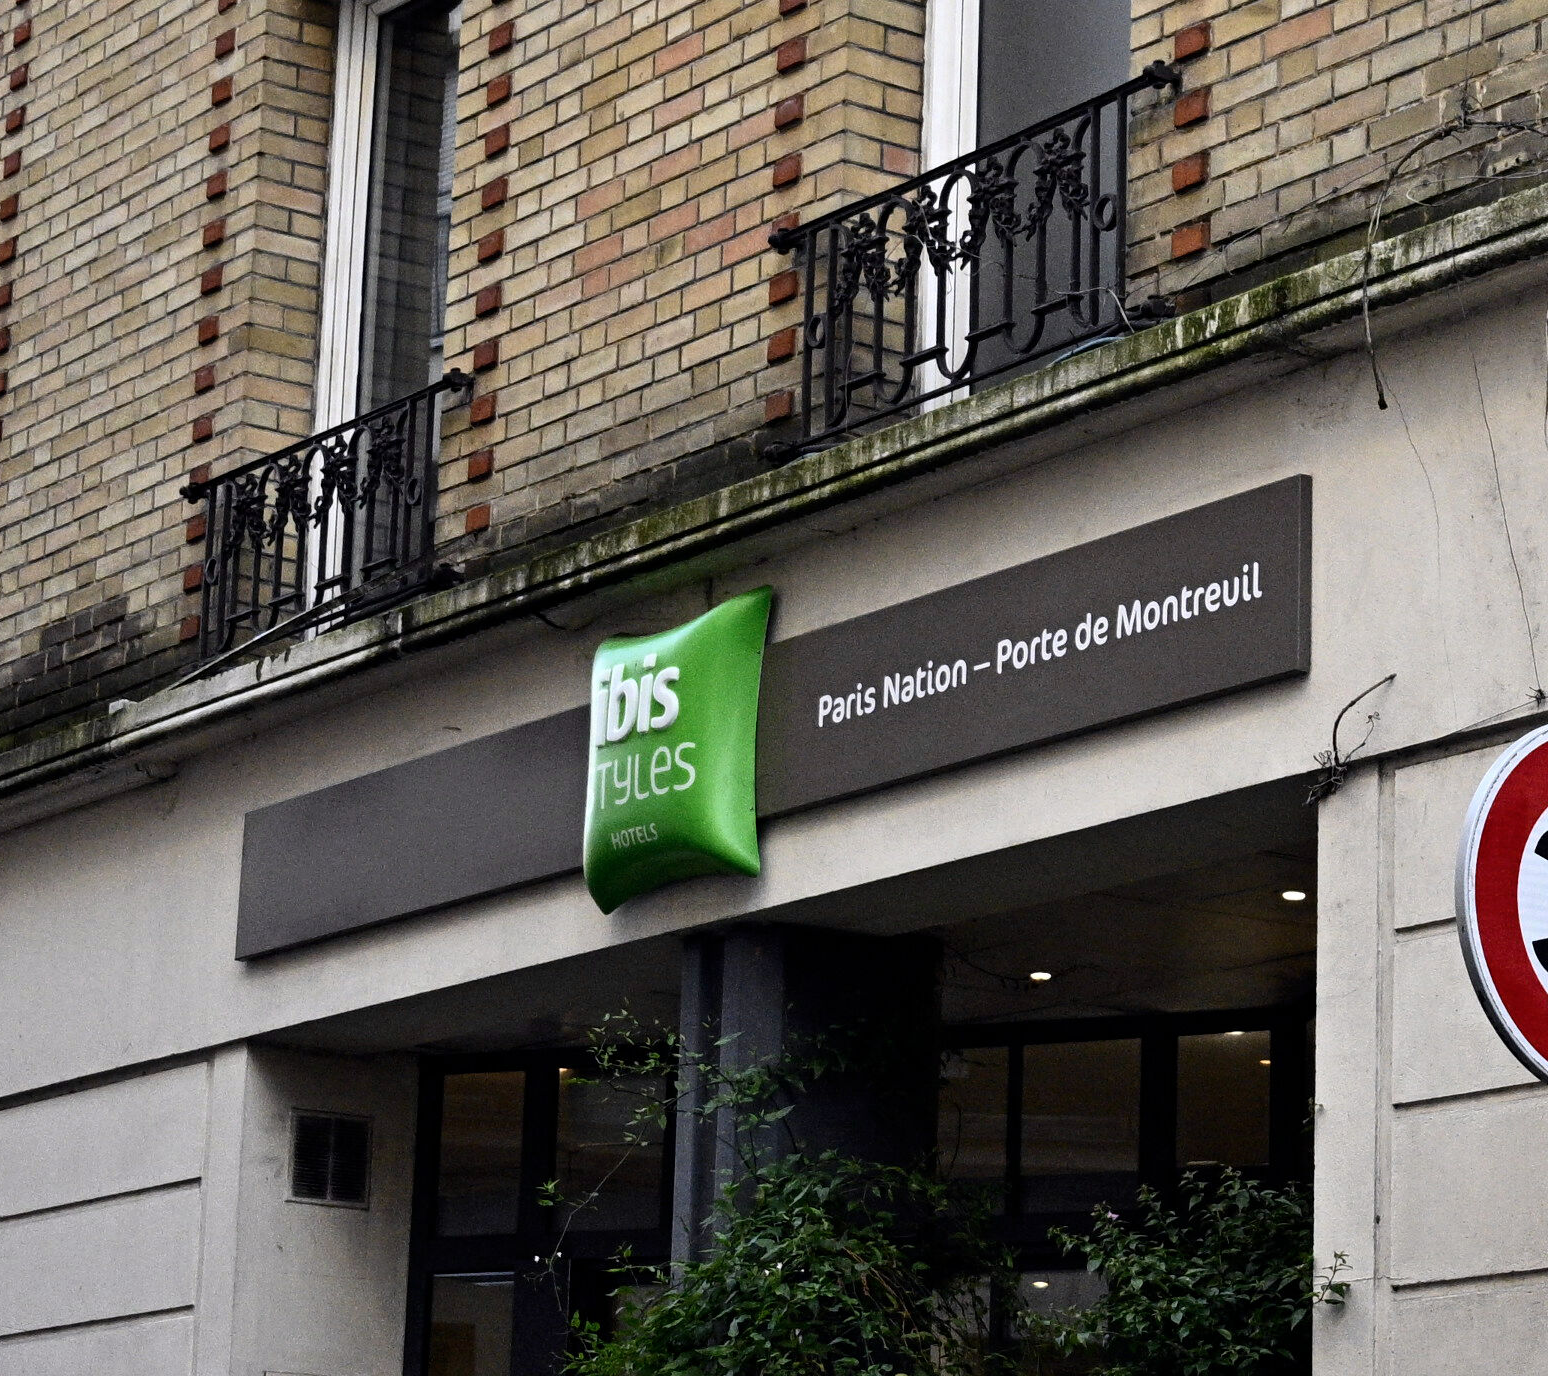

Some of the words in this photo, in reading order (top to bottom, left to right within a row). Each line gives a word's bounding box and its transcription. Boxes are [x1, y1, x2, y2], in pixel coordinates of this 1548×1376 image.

[818, 683, 876, 728] Paris
[883, 659, 967, 708] Nation
[996, 628, 1067, 674] Porte
[1075, 613, 1108, 651] de
[1116, 561, 1263, 639] Montreuil
[595, 653, 680, 747] ibis
[611, 823, 658, 851] HOTELS
